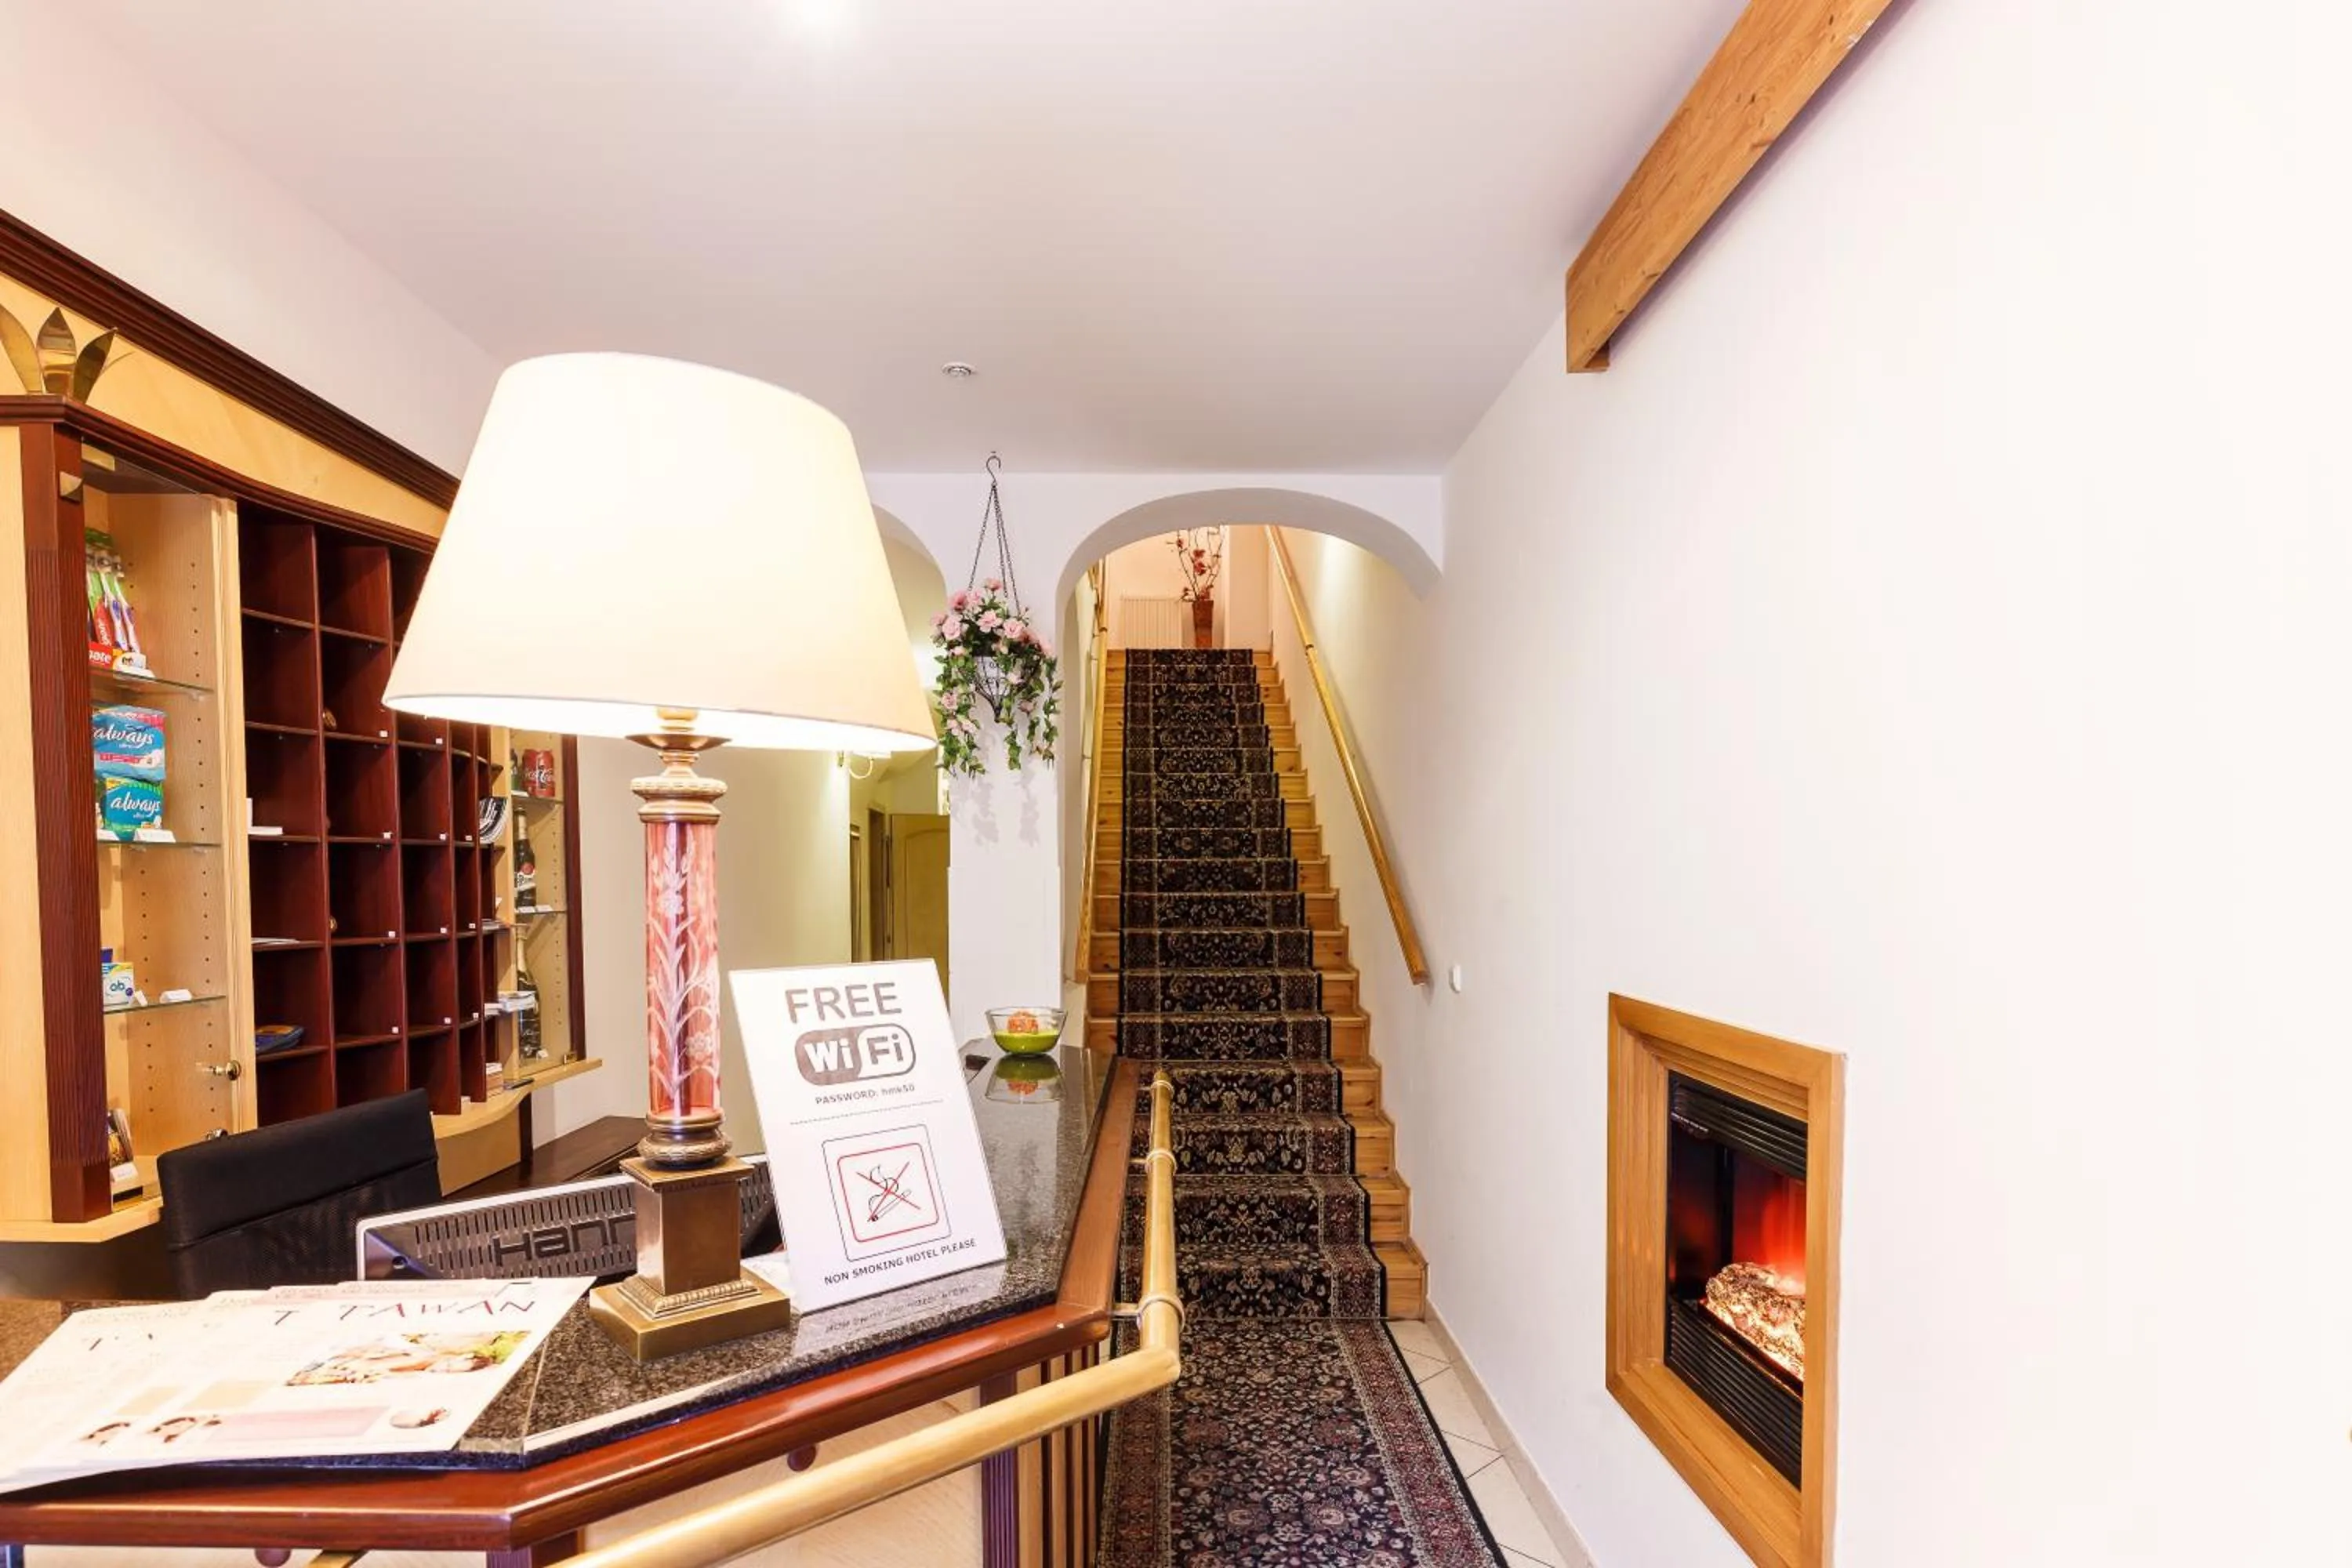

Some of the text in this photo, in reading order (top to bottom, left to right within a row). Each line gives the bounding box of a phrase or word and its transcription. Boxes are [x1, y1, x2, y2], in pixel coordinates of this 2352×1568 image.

[93, 723, 154, 748] always
[111, 791, 161, 818] always
[785, 982, 902, 1024] FREE
[804, 1033, 904, 1073] WiFi
[815, 1088, 879, 1105] PASSWORD:
[824, 1238, 978, 1286] NON SMOKING HOTEL PLEASE
